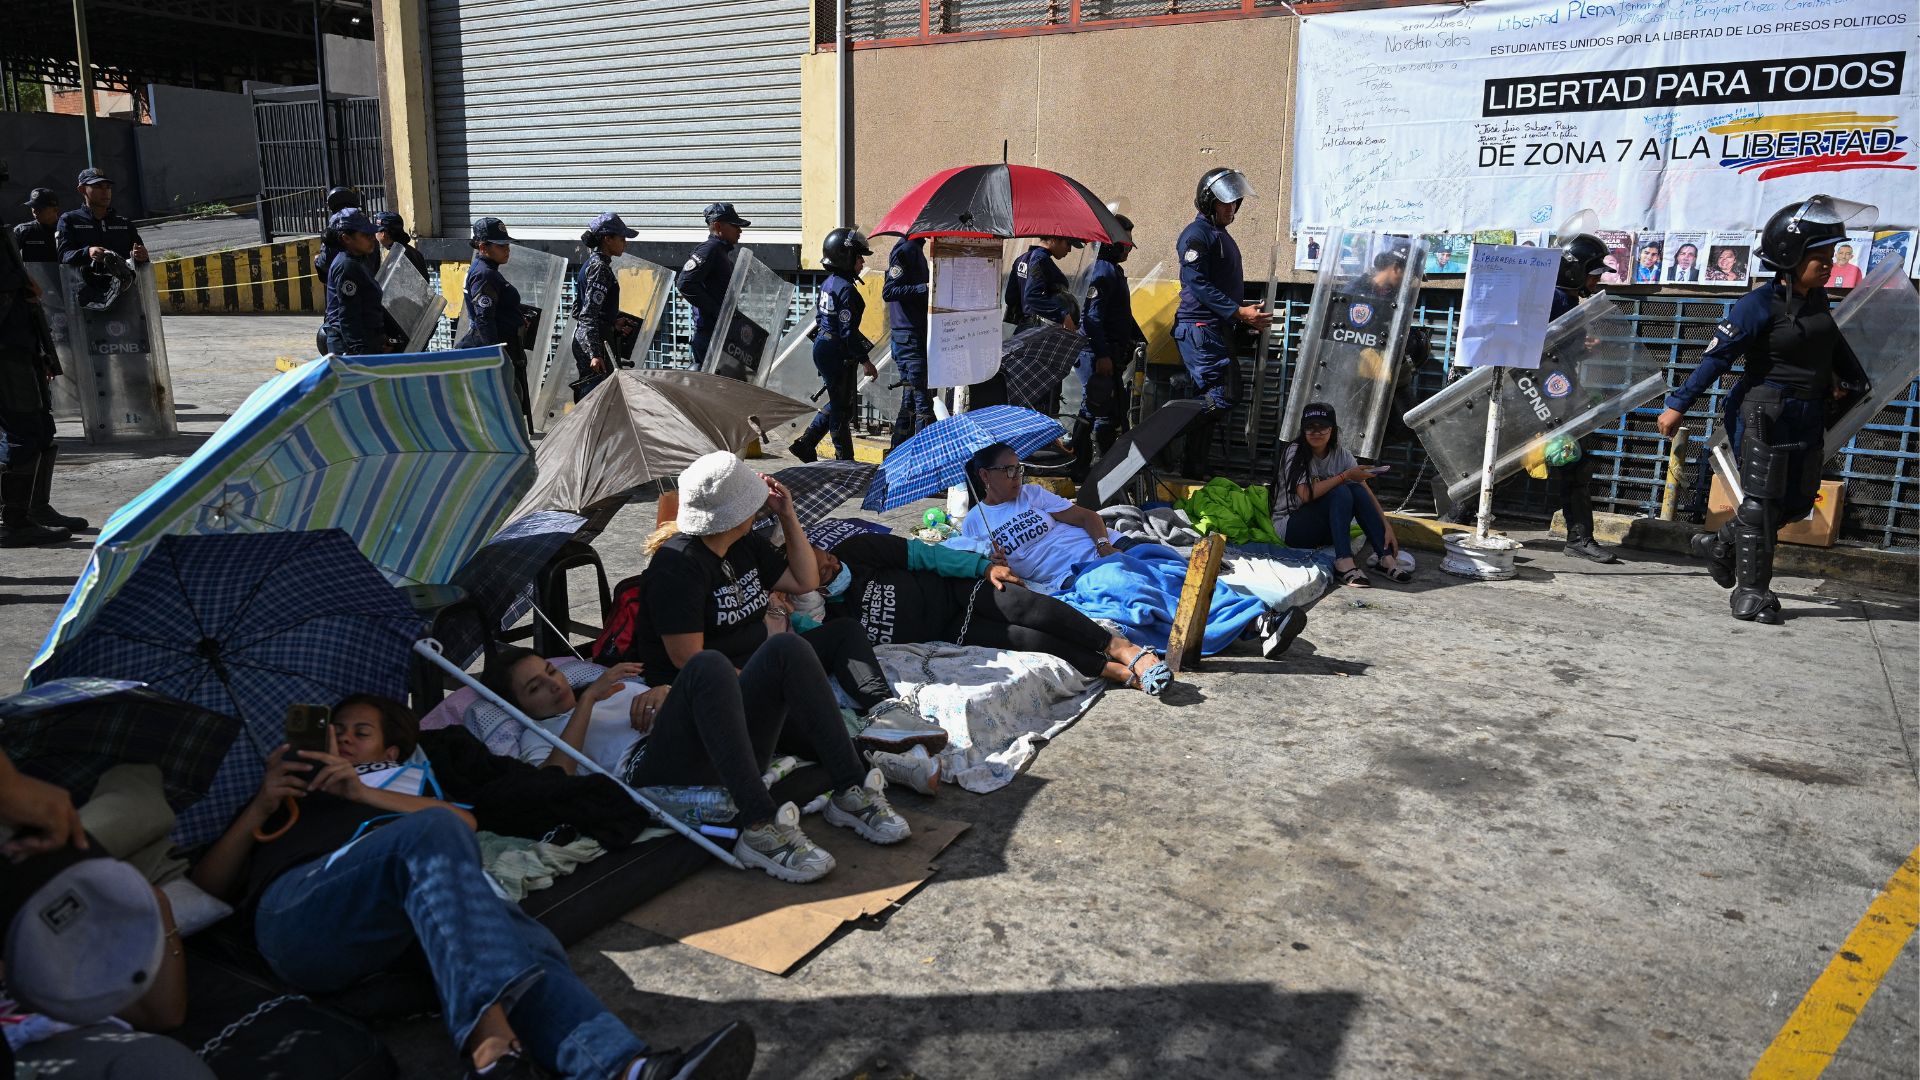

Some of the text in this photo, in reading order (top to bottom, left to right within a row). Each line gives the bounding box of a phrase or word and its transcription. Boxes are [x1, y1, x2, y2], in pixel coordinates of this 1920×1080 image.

[1490, 13, 1907, 56] ESTUDIANTES UNIDOS POR LA LIBERTAD DE LOS PRESOS POLITICOS
[1488, 60, 1896, 111] LIBERTAD PARA TODOS
[1478, 144, 1516, 168] DE
[1523, 139, 1606, 166] ZONA
[1616, 139, 1633, 163] 7
[1639, 137, 1662, 161] A
[1670, 135, 1711, 160] LA
[1722, 128, 1895, 160] LIBERTAD
[99, 343, 140, 354] CPNB
[728, 343, 754, 367] CPNB
[1333, 329, 1377, 347] CPNB
[1517, 377, 1552, 422] CPNB
[816, 522, 855, 551] UTIVOS
[992, 520, 1012, 539] BEREN
[996, 514, 1043, 546] OS PRESOS
[1003, 522, 1049, 556] OLÍTICOS
[868, 583, 882, 646] OS PRESOS
[880, 584, 896, 645] OLÍTICOS
